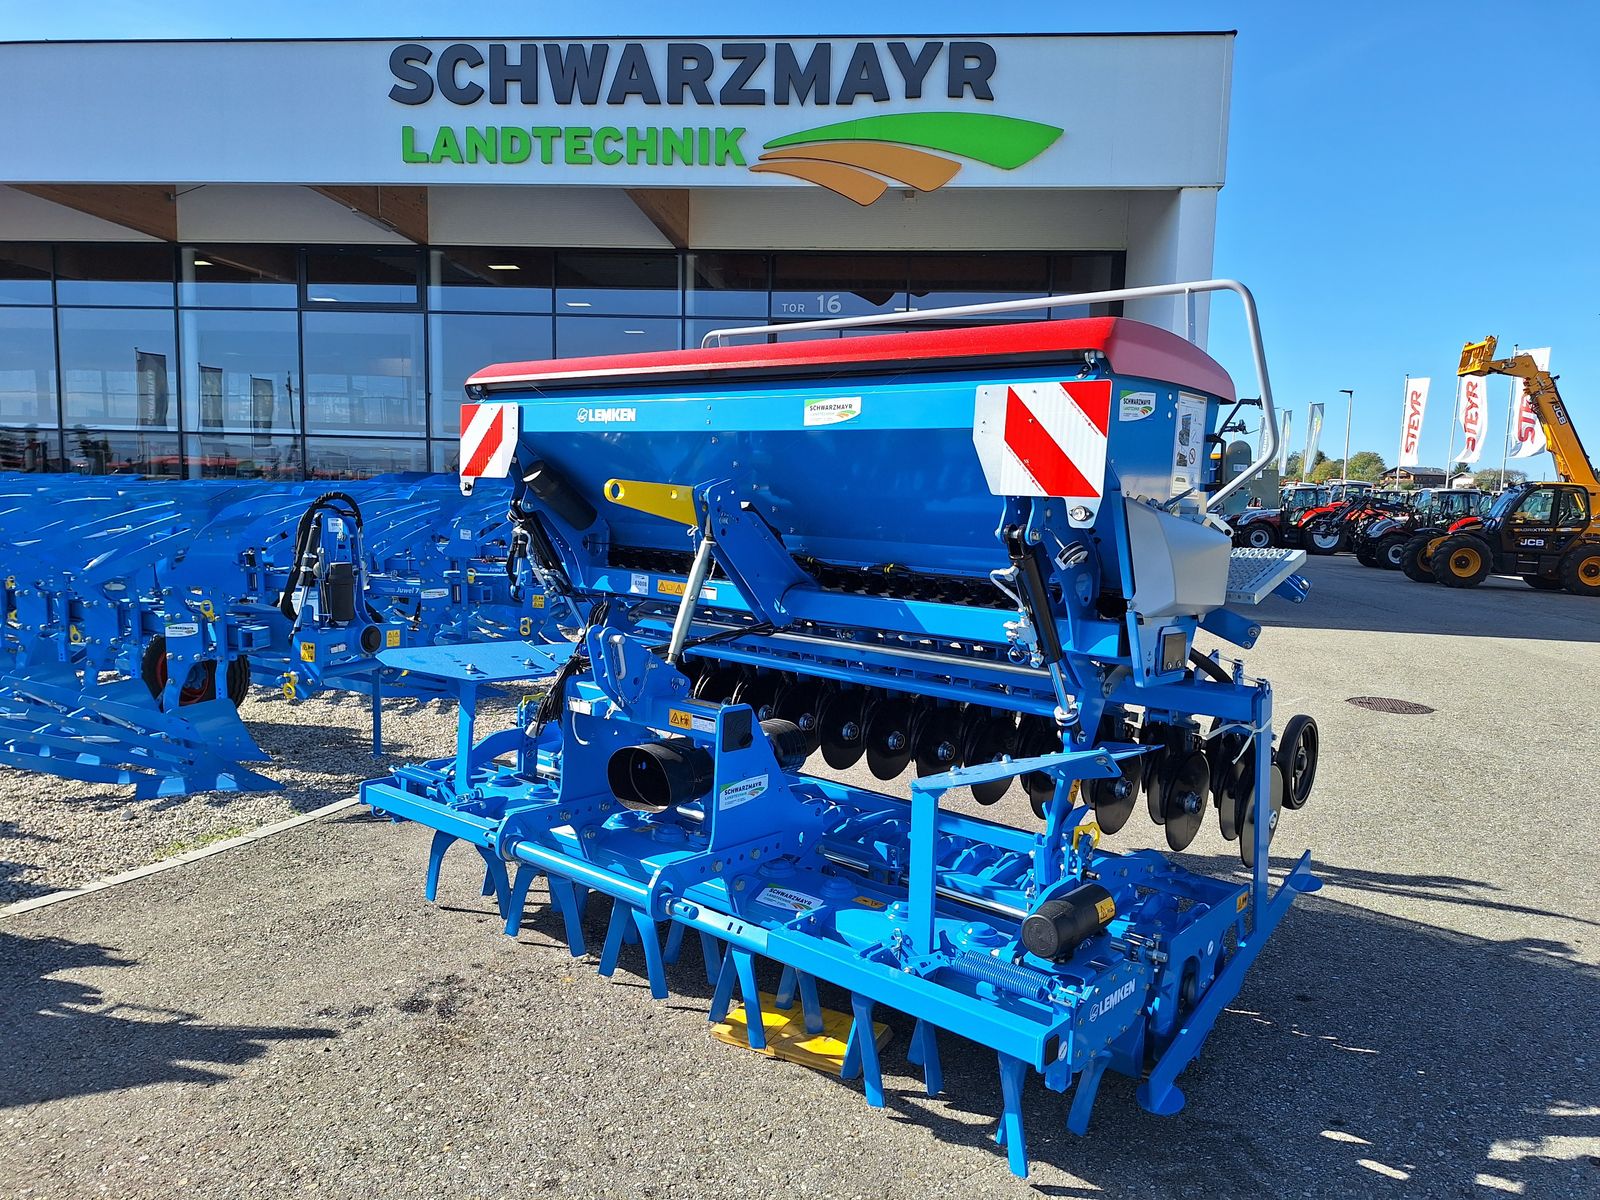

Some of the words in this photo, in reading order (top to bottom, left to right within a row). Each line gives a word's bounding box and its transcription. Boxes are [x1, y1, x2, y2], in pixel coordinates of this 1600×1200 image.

[389, 41, 997, 106] SCHWARZMAYR
[402, 126, 747, 166] LANDTECHNIK
[782, 303, 805, 313] TOR
[816, 294, 842, 314] 16
[588, 407, 637, 424] LEMKEN
[809, 403, 853, 411] SCHWARZMAYR
[1463, 380, 1480, 452] STEYR
[1553, 404, 1567, 425] JCB
[1405, 390, 1422, 455] STEYR
[1520, 538, 1545, 547] JCB
[396, 586, 415, 595] Juwel
[724, 781, 762, 796] SCHWARZMAYR
[768, 888, 813, 906] SCHWARZMAYR
[1098, 977, 1136, 1016] LEMKEN
